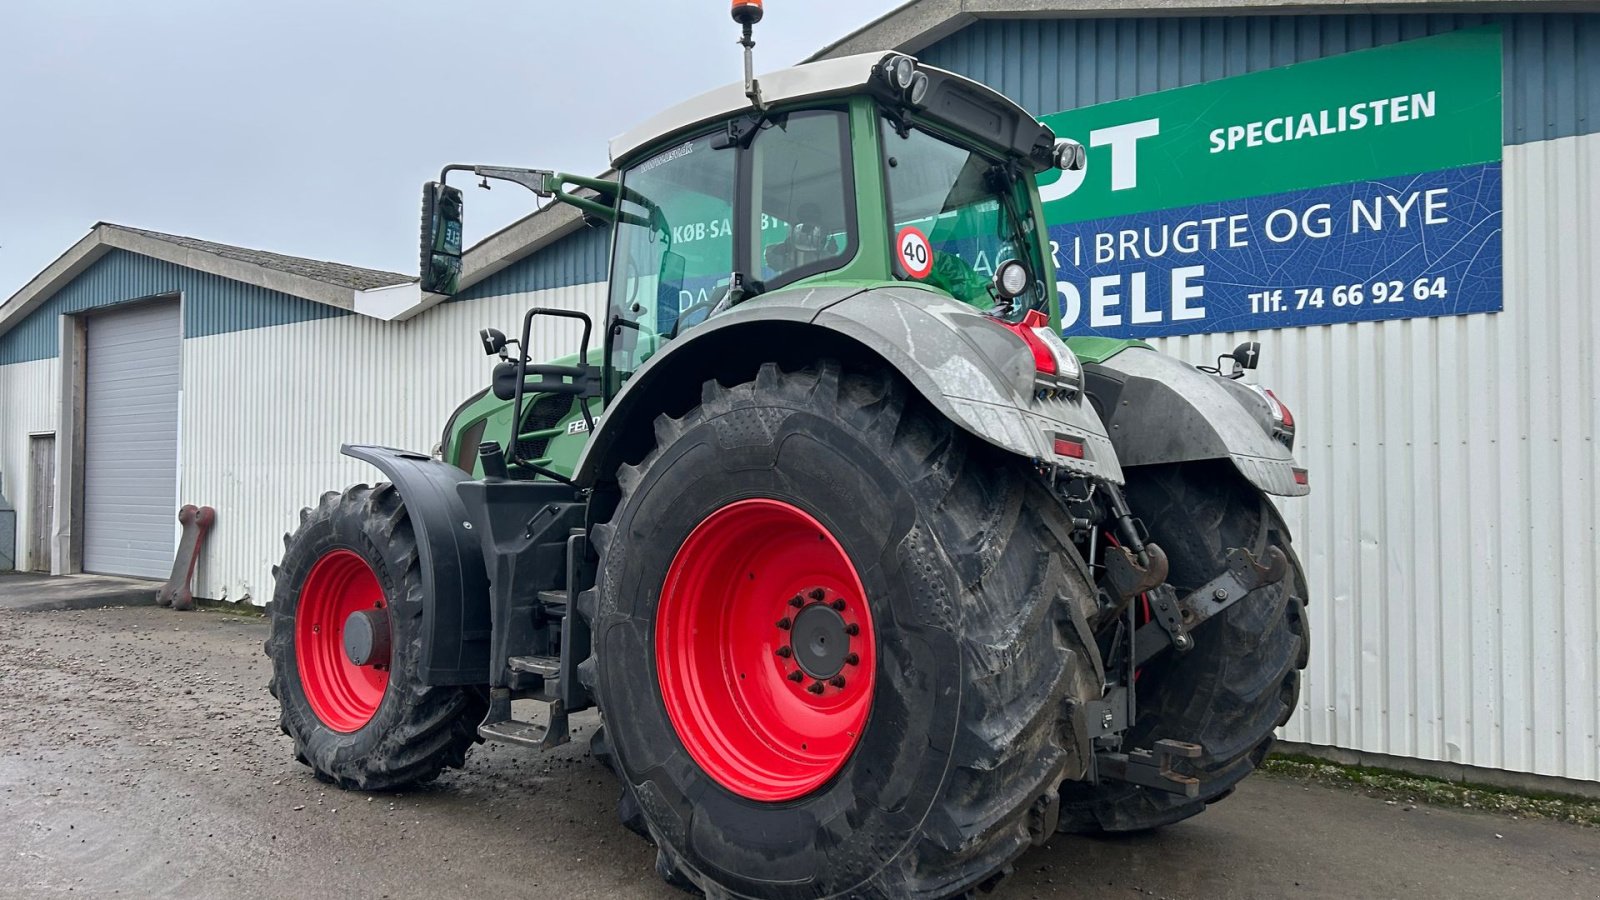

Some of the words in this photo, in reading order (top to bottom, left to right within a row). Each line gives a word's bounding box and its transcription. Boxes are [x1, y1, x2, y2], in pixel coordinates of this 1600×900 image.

[1209, 91, 1436, 153] SPECIALISTEN
[1095, 213, 1249, 264] BRUGTE
[1265, 203, 1332, 243] OG
[1352, 187, 1449, 235] NYE
[904, 241, 926, 264] 40
[1247, 291, 1287, 314] Tlf.
[1293, 287, 1325, 311] 74
[1332, 283, 1364, 307] 66
[1372, 280, 1404, 304] 92
[1413, 276, 1448, 300] 64
